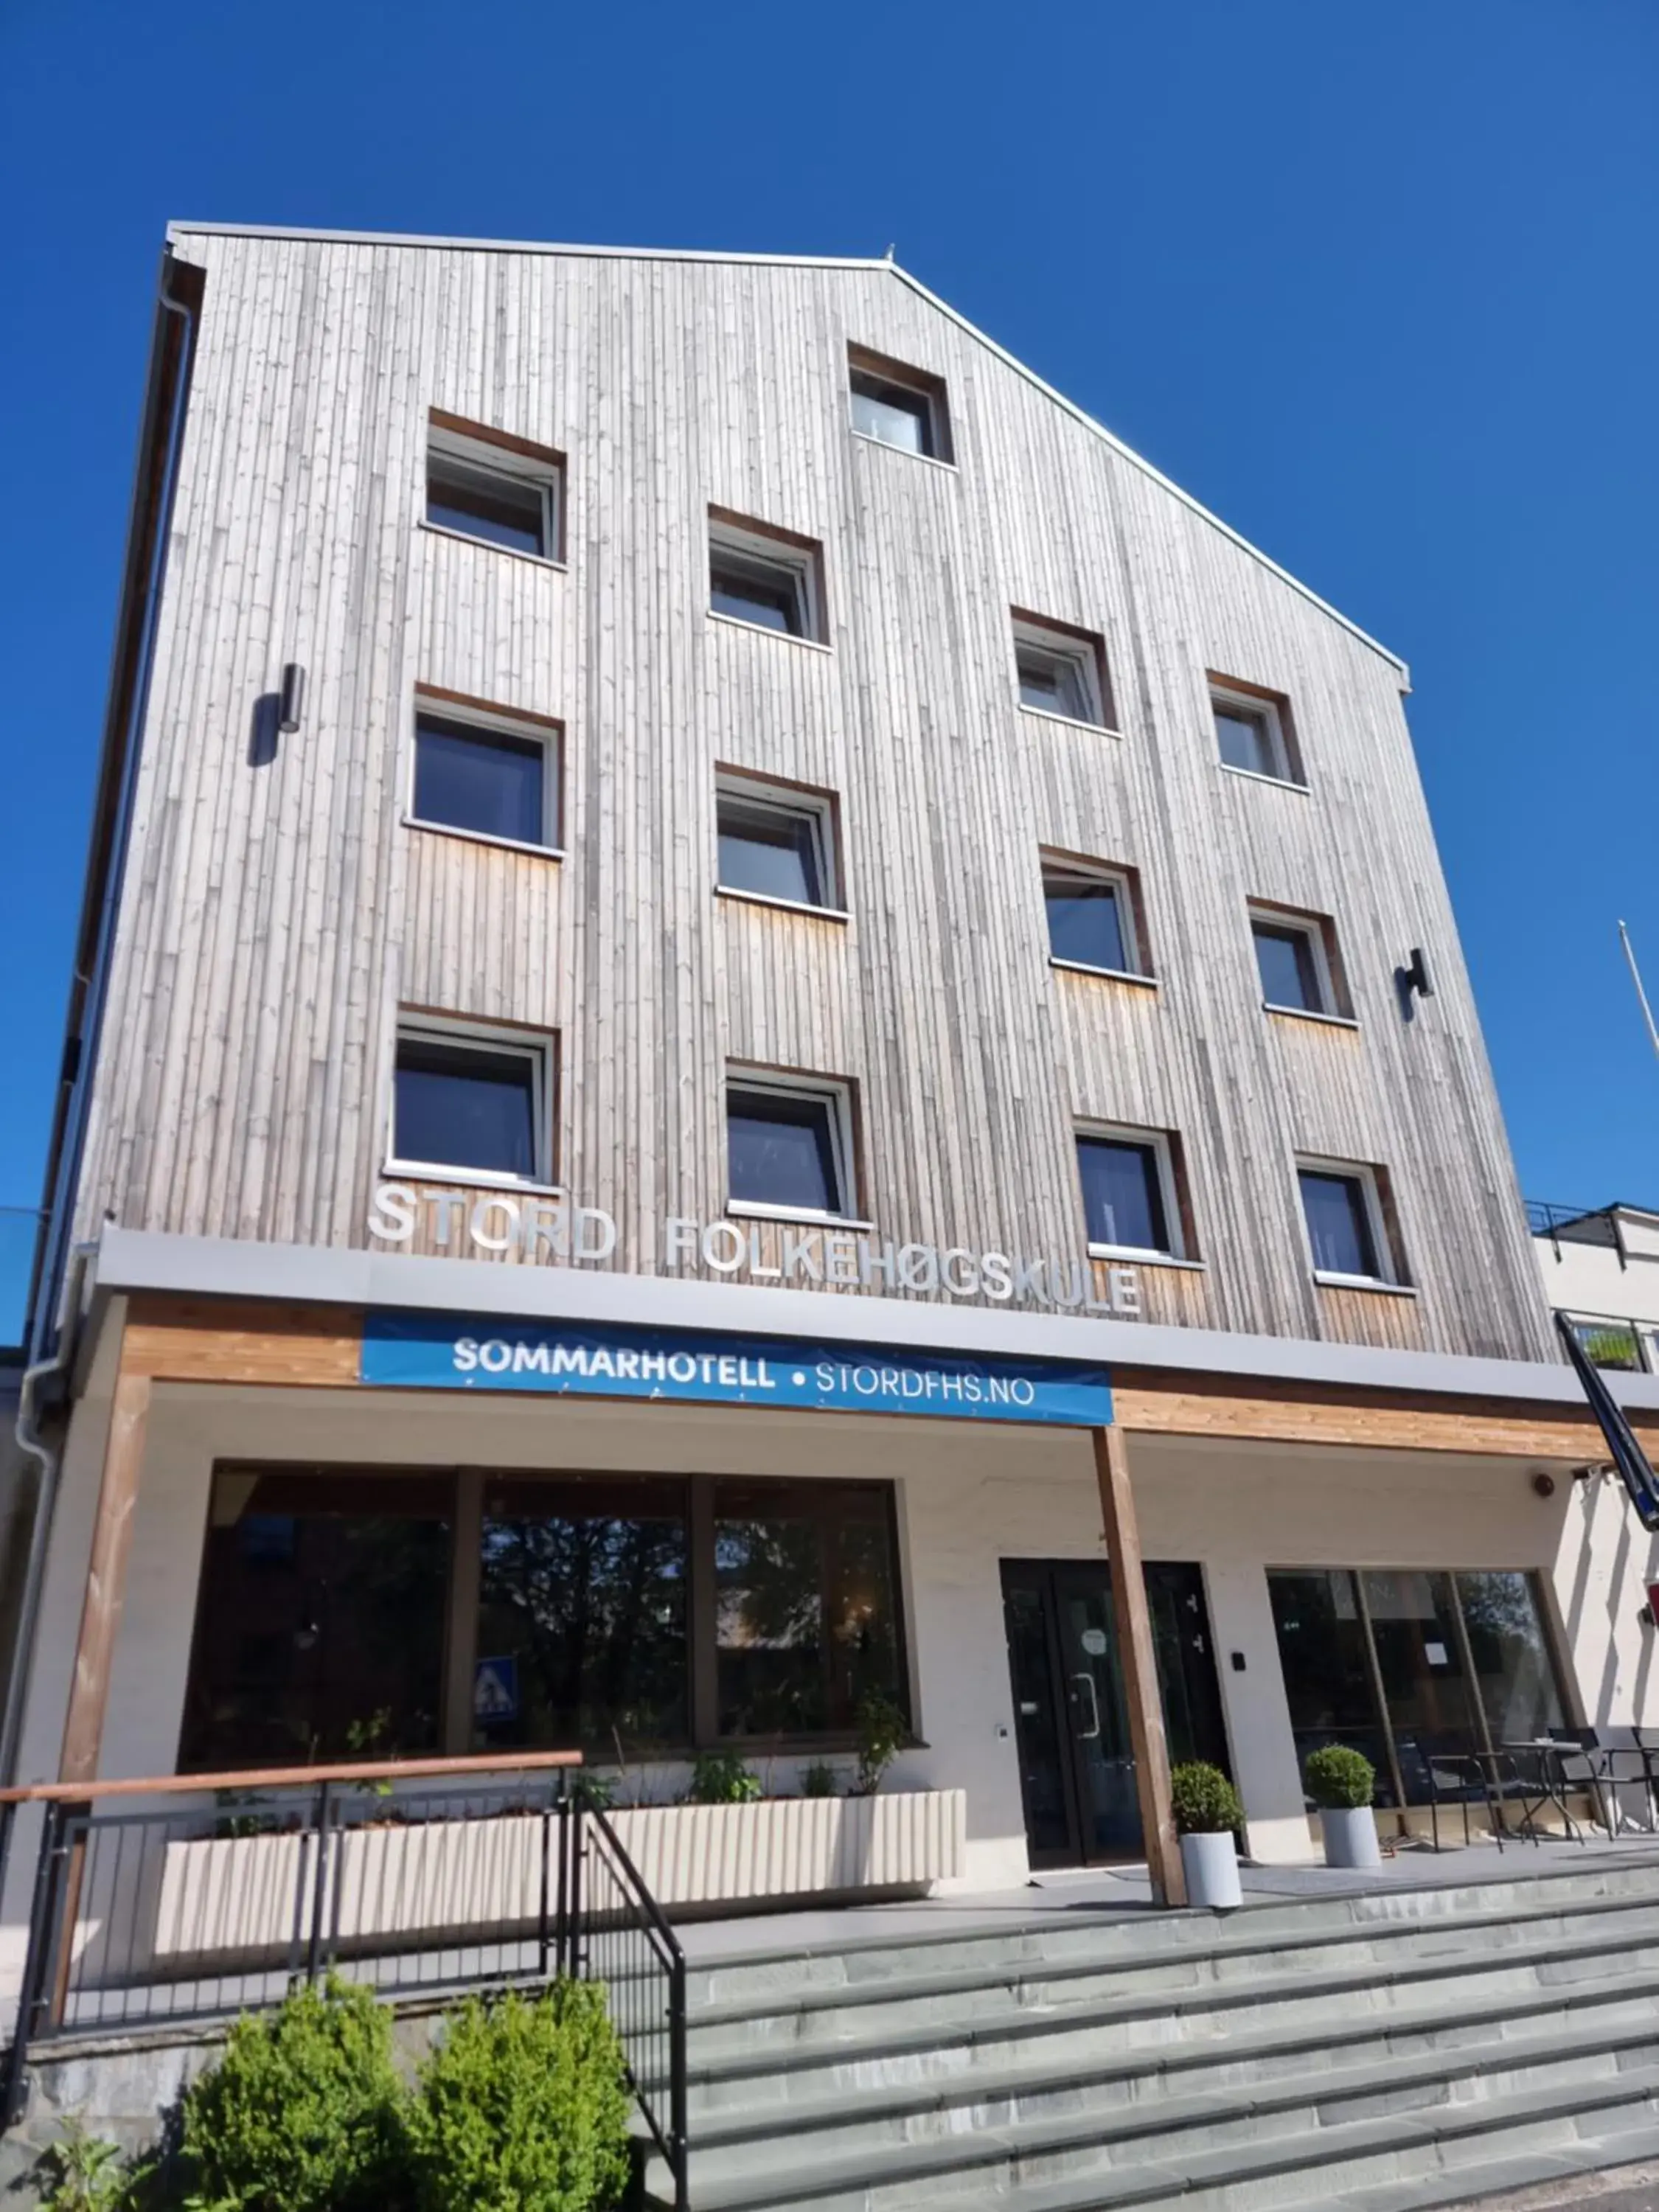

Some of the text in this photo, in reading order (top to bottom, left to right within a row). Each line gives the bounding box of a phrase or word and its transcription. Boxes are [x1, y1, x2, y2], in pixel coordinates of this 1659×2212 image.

[368, 1184, 1142, 1314] STORD FOLKEHØGSKULE
[453, 1337, 1034, 1405] SOMMARHOTELL STORDFHS.NO
